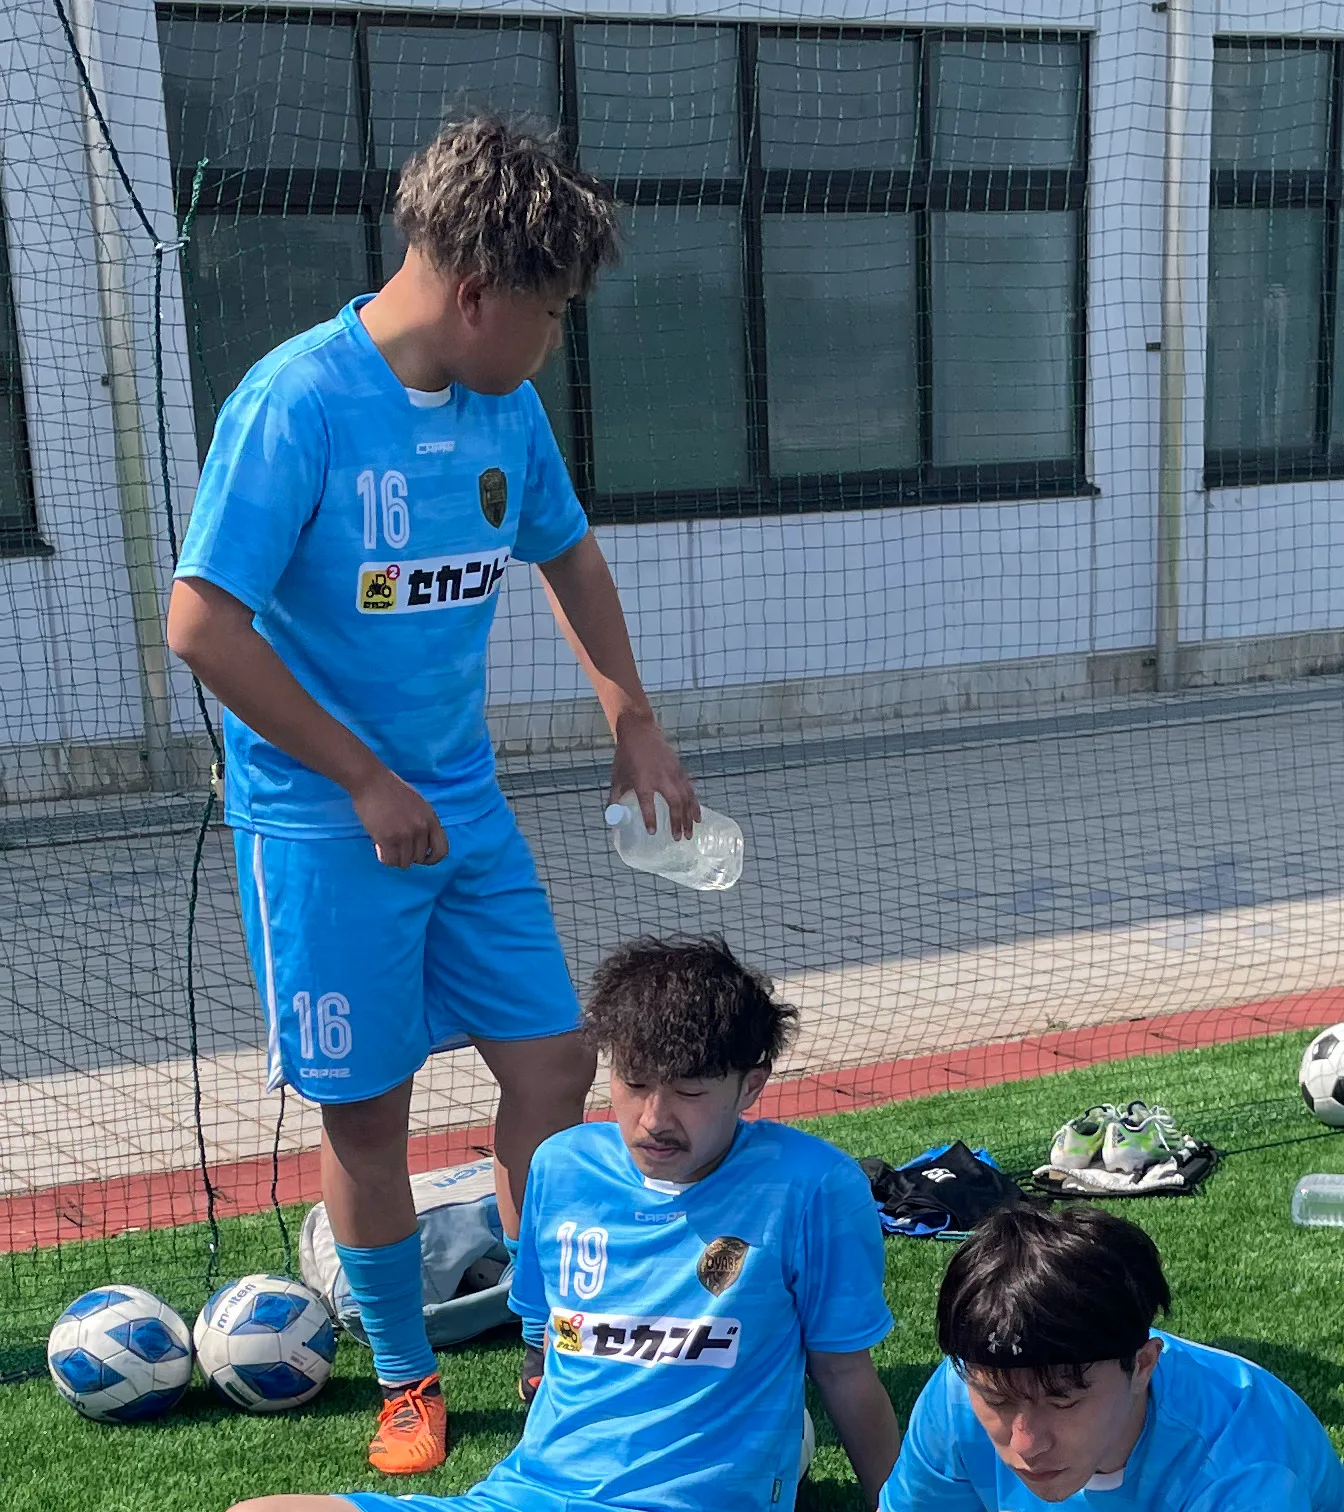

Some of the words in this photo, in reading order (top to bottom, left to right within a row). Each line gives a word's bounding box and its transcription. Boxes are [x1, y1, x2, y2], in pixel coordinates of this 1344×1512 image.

[357, 470, 410, 550] 16
[293, 991, 353, 1060] 16
[557, 1221, 609, 1300] 19
[593, 1323, 739, 1362] セカンド
